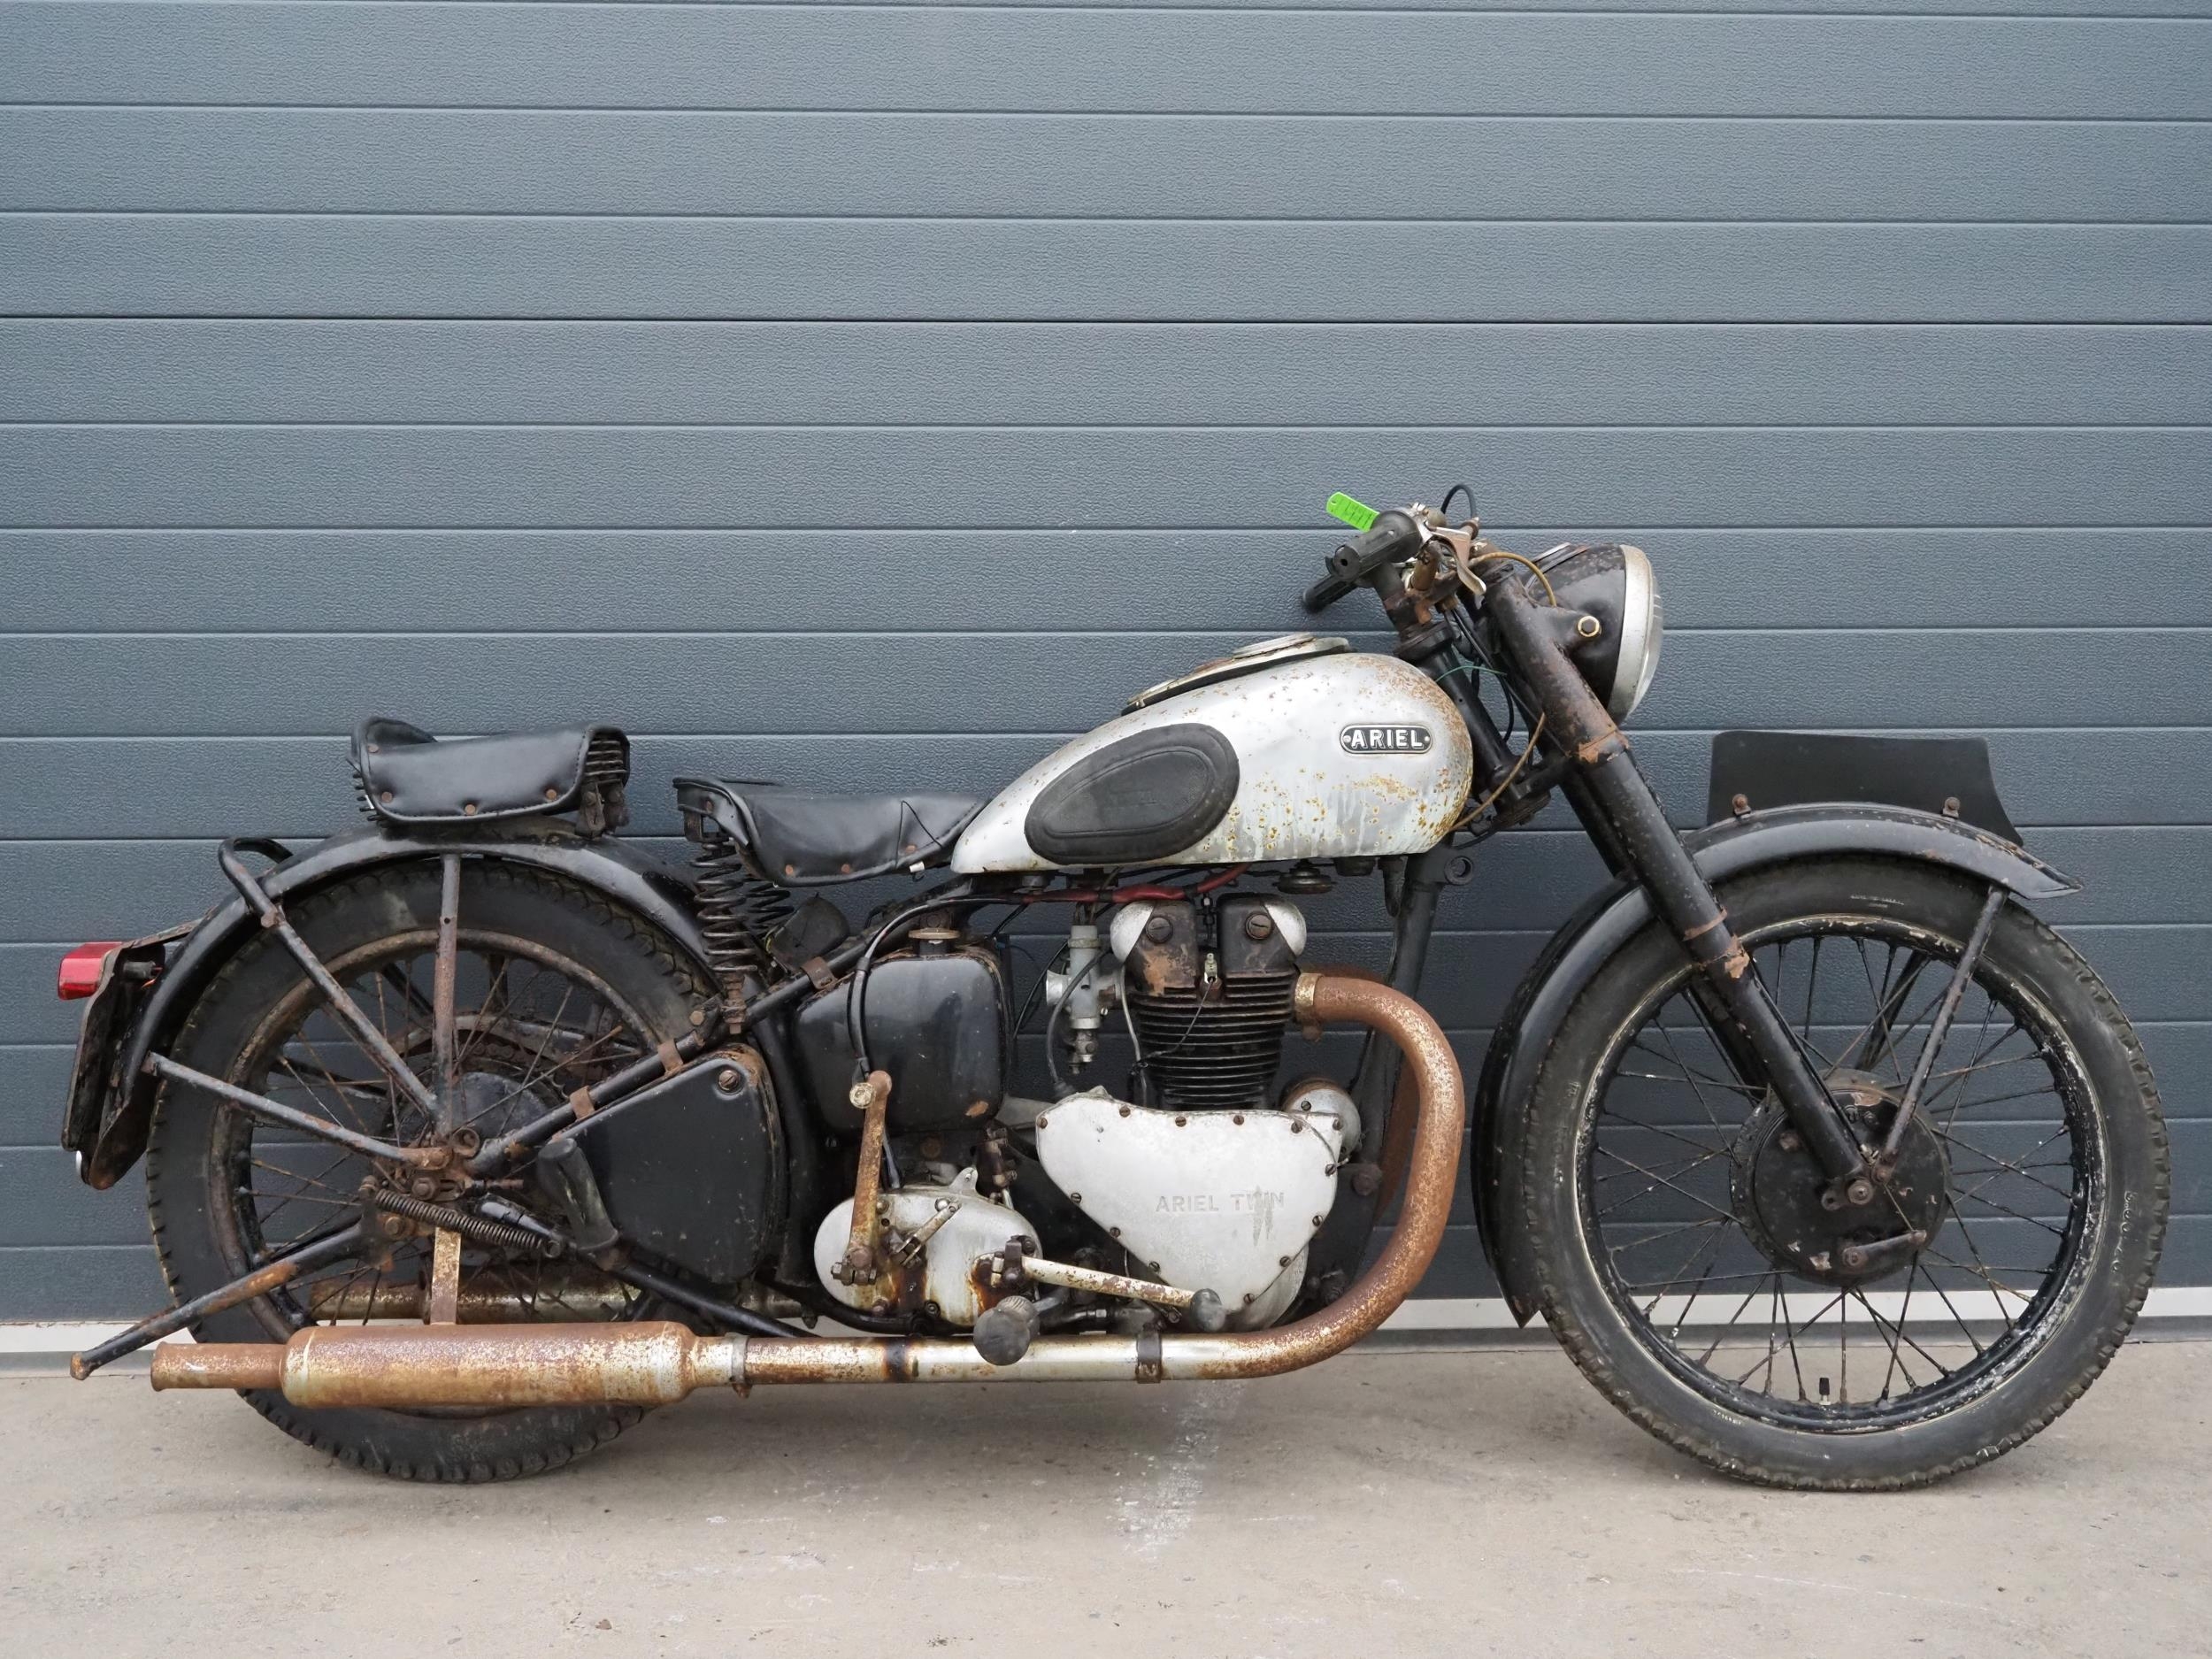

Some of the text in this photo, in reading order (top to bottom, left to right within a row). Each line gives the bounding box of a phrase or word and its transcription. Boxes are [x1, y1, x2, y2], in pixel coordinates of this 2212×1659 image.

[1351, 729, 1424, 749] ARIEL
[1156, 1192, 1284, 1212] ARIEL TWIN
